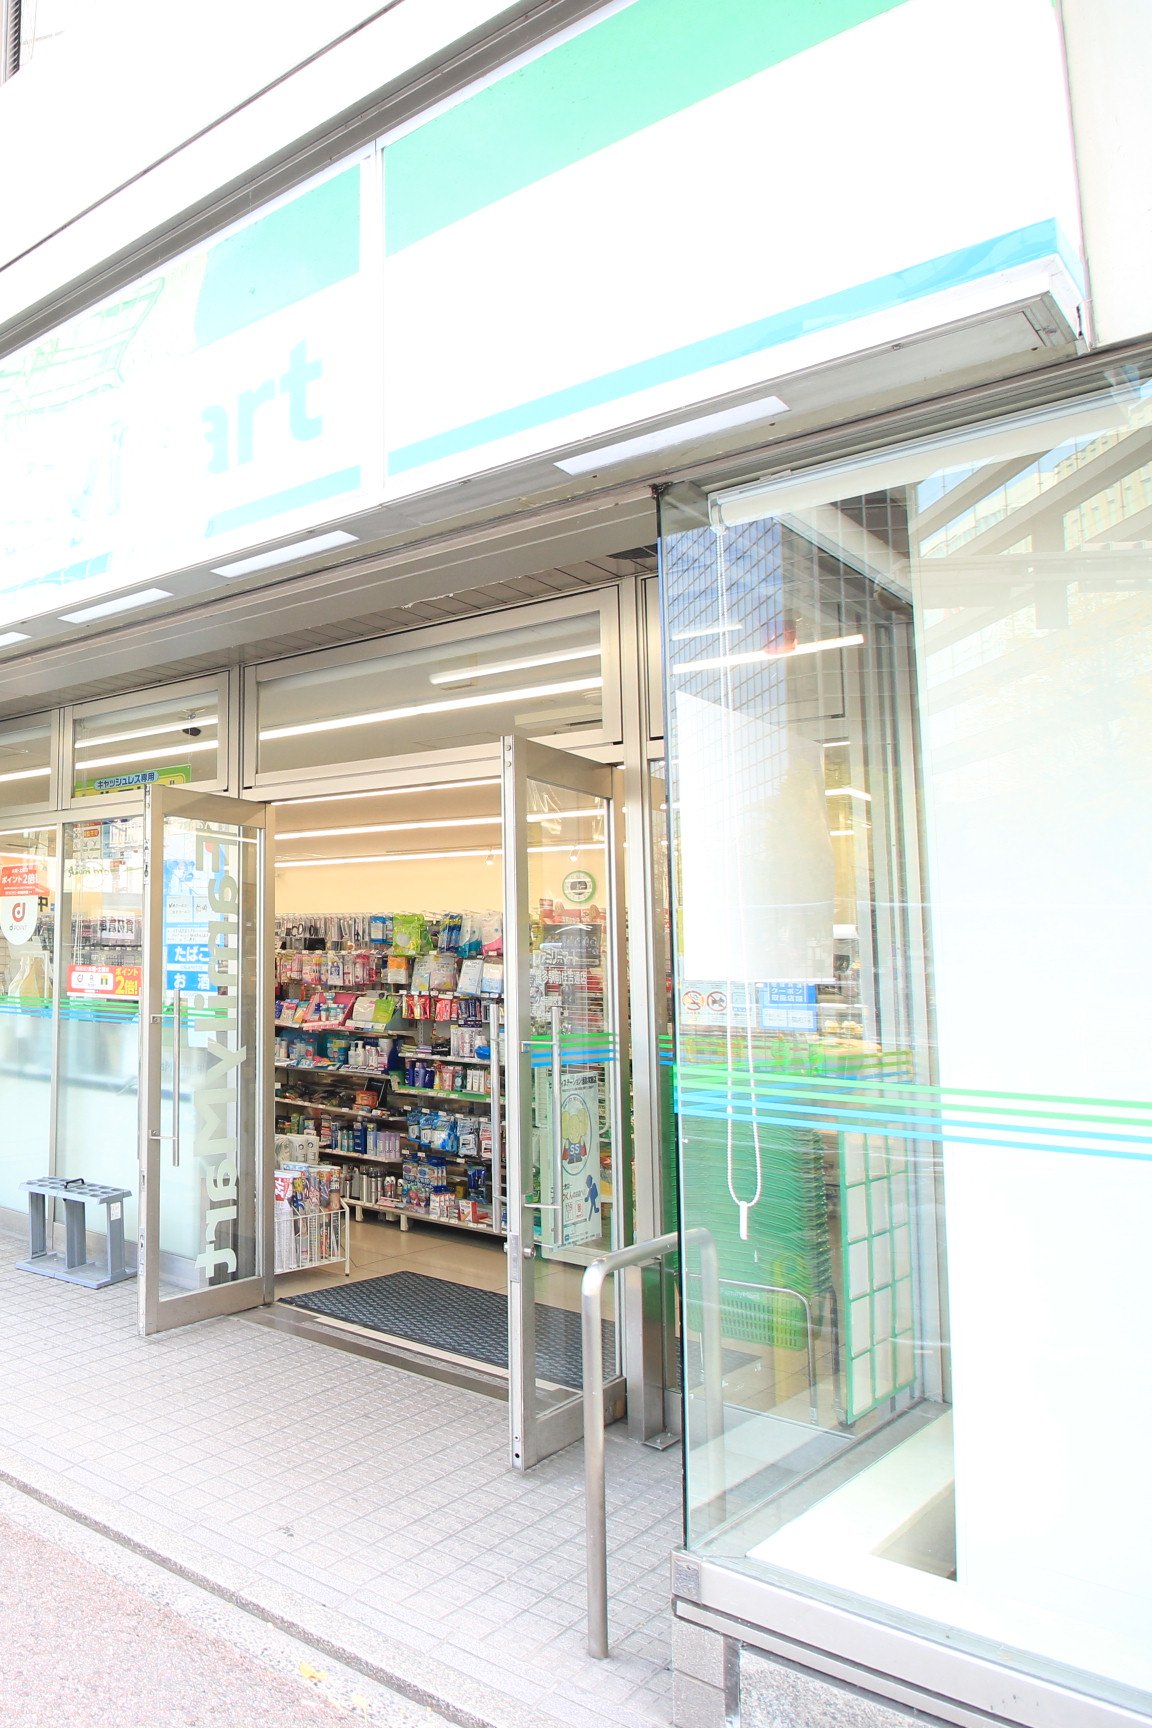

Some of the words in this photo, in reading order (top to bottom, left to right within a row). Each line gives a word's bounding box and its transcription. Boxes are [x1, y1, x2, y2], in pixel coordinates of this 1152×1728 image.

[96, 772, 155, 789] キャッシュレス専用
[174, 946, 209, 962] たばこ
[115, 968, 138, 976] ポイント
[115, 976, 138, 995] 2倍!
[569, 1144, 580, 1155] SS
